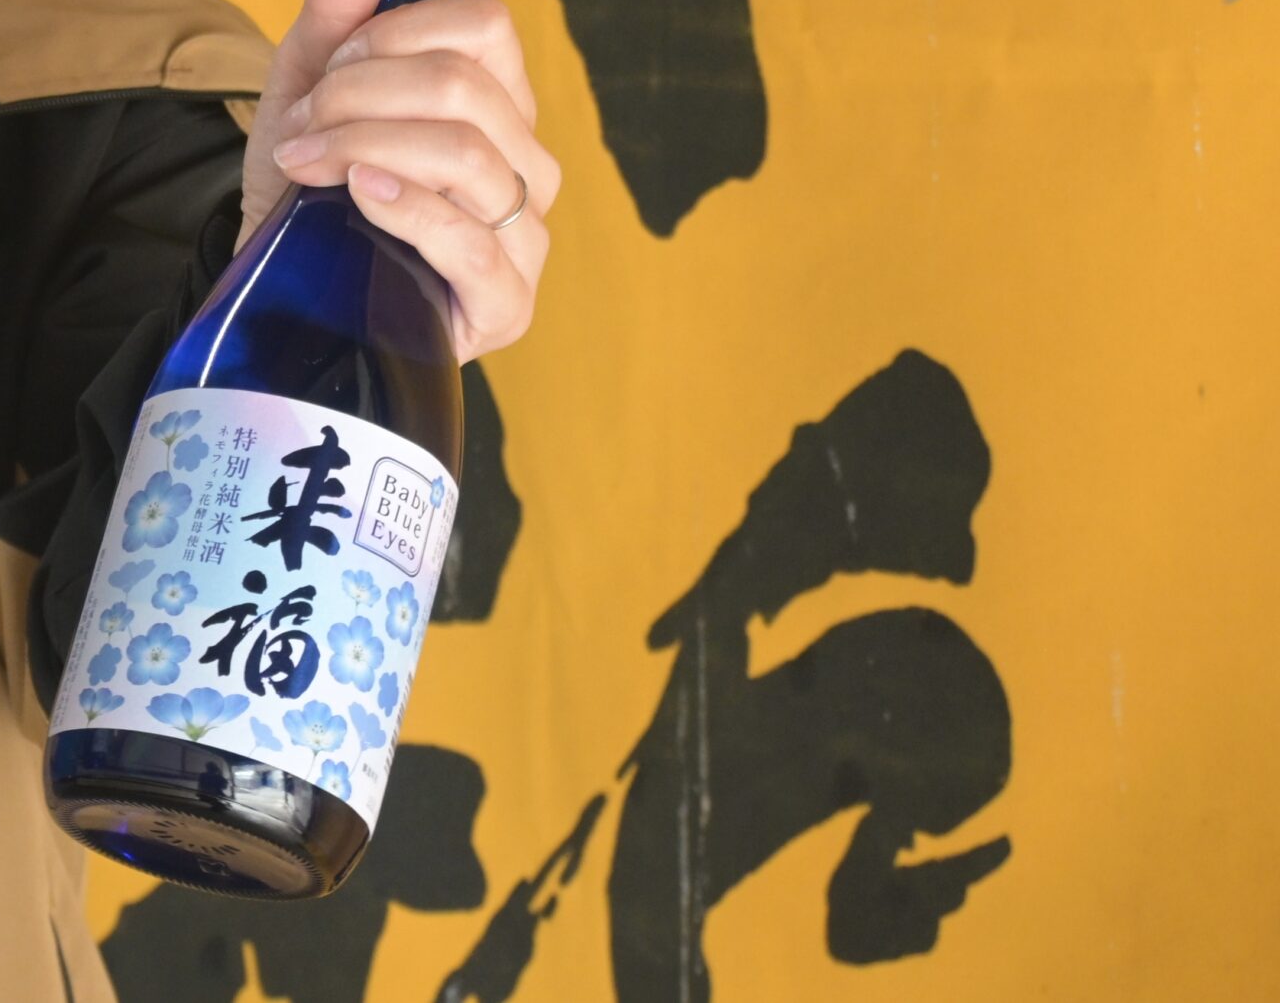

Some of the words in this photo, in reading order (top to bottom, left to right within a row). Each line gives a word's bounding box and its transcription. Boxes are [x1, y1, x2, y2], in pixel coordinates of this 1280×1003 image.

[182, 425, 229, 563] ネモフィラ花酵母使用
[199, 426, 258, 565] 特別純米酒
[377, 497, 422, 539] Blue
[382, 474, 429, 519] Baby
[199, 425, 353, 699] 来福
[370, 519, 417, 561] Eyes
